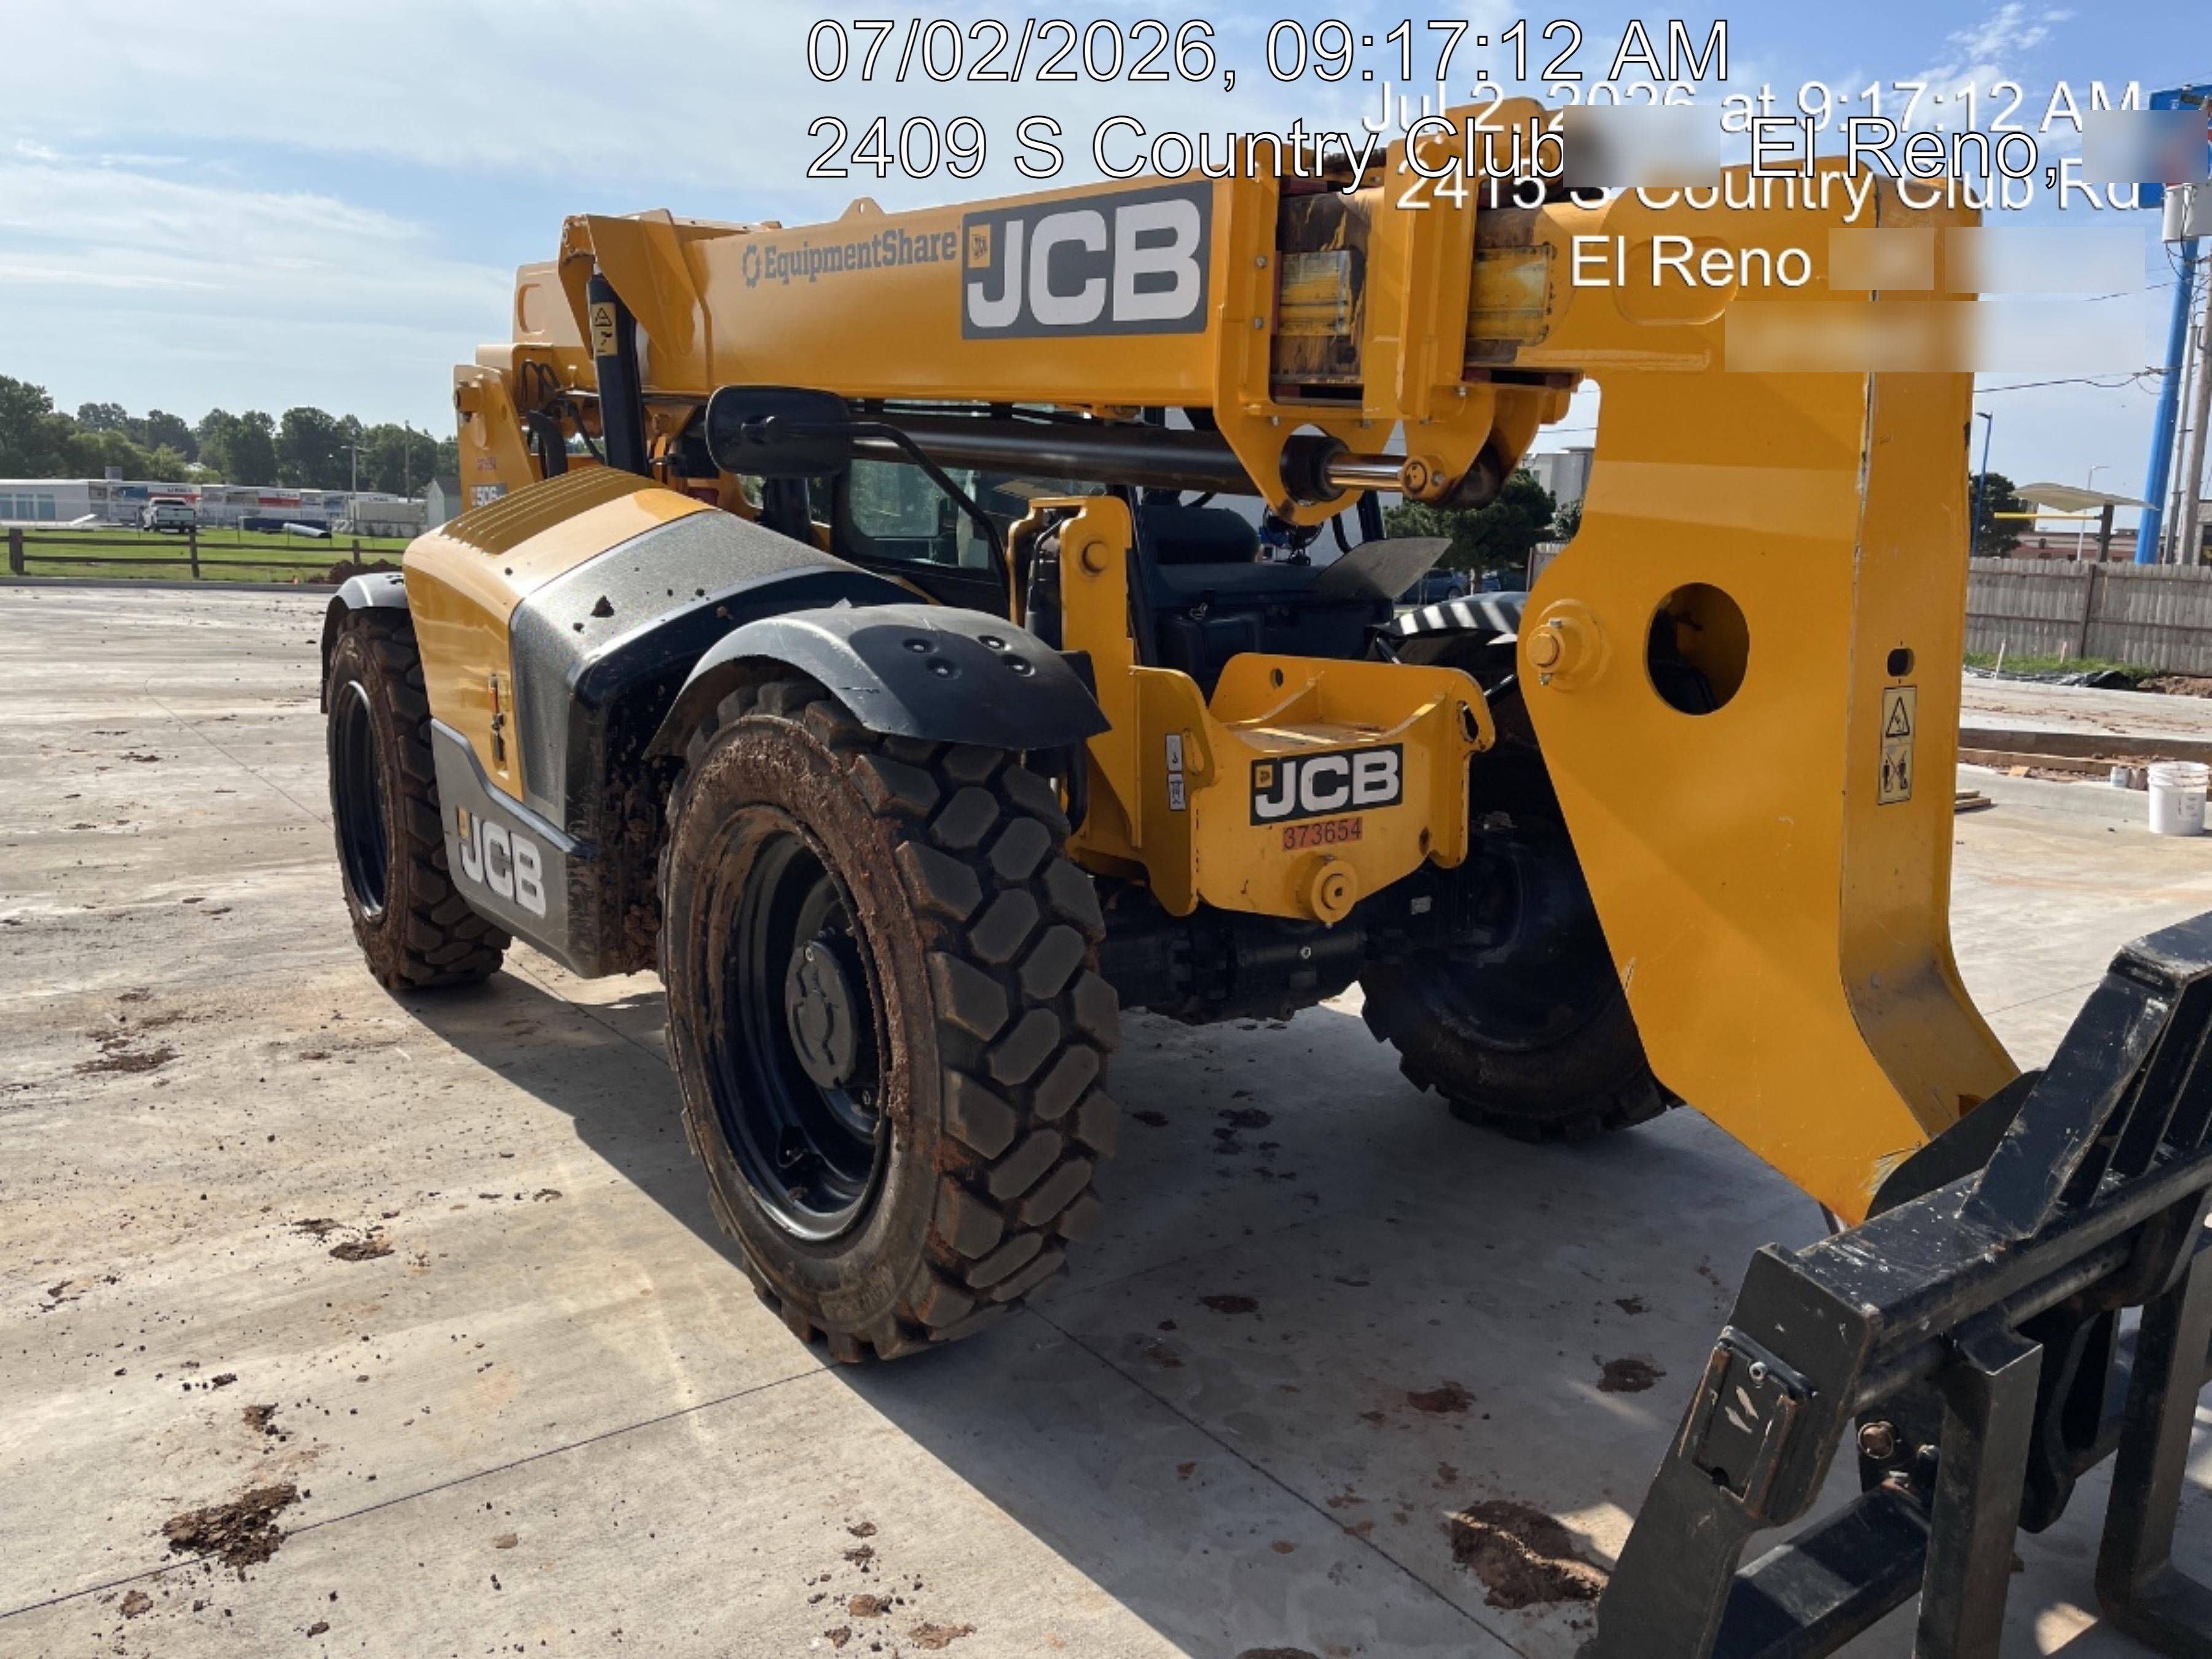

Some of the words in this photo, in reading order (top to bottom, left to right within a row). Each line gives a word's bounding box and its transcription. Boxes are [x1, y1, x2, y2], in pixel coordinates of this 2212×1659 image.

[764, 228, 957, 285] EquipmentShare
[967, 198, 1201, 328] JCB
[1255, 750, 1400, 818] JCB
[461, 815, 546, 918] JCB
[1284, 818, 1362, 849] 373654
